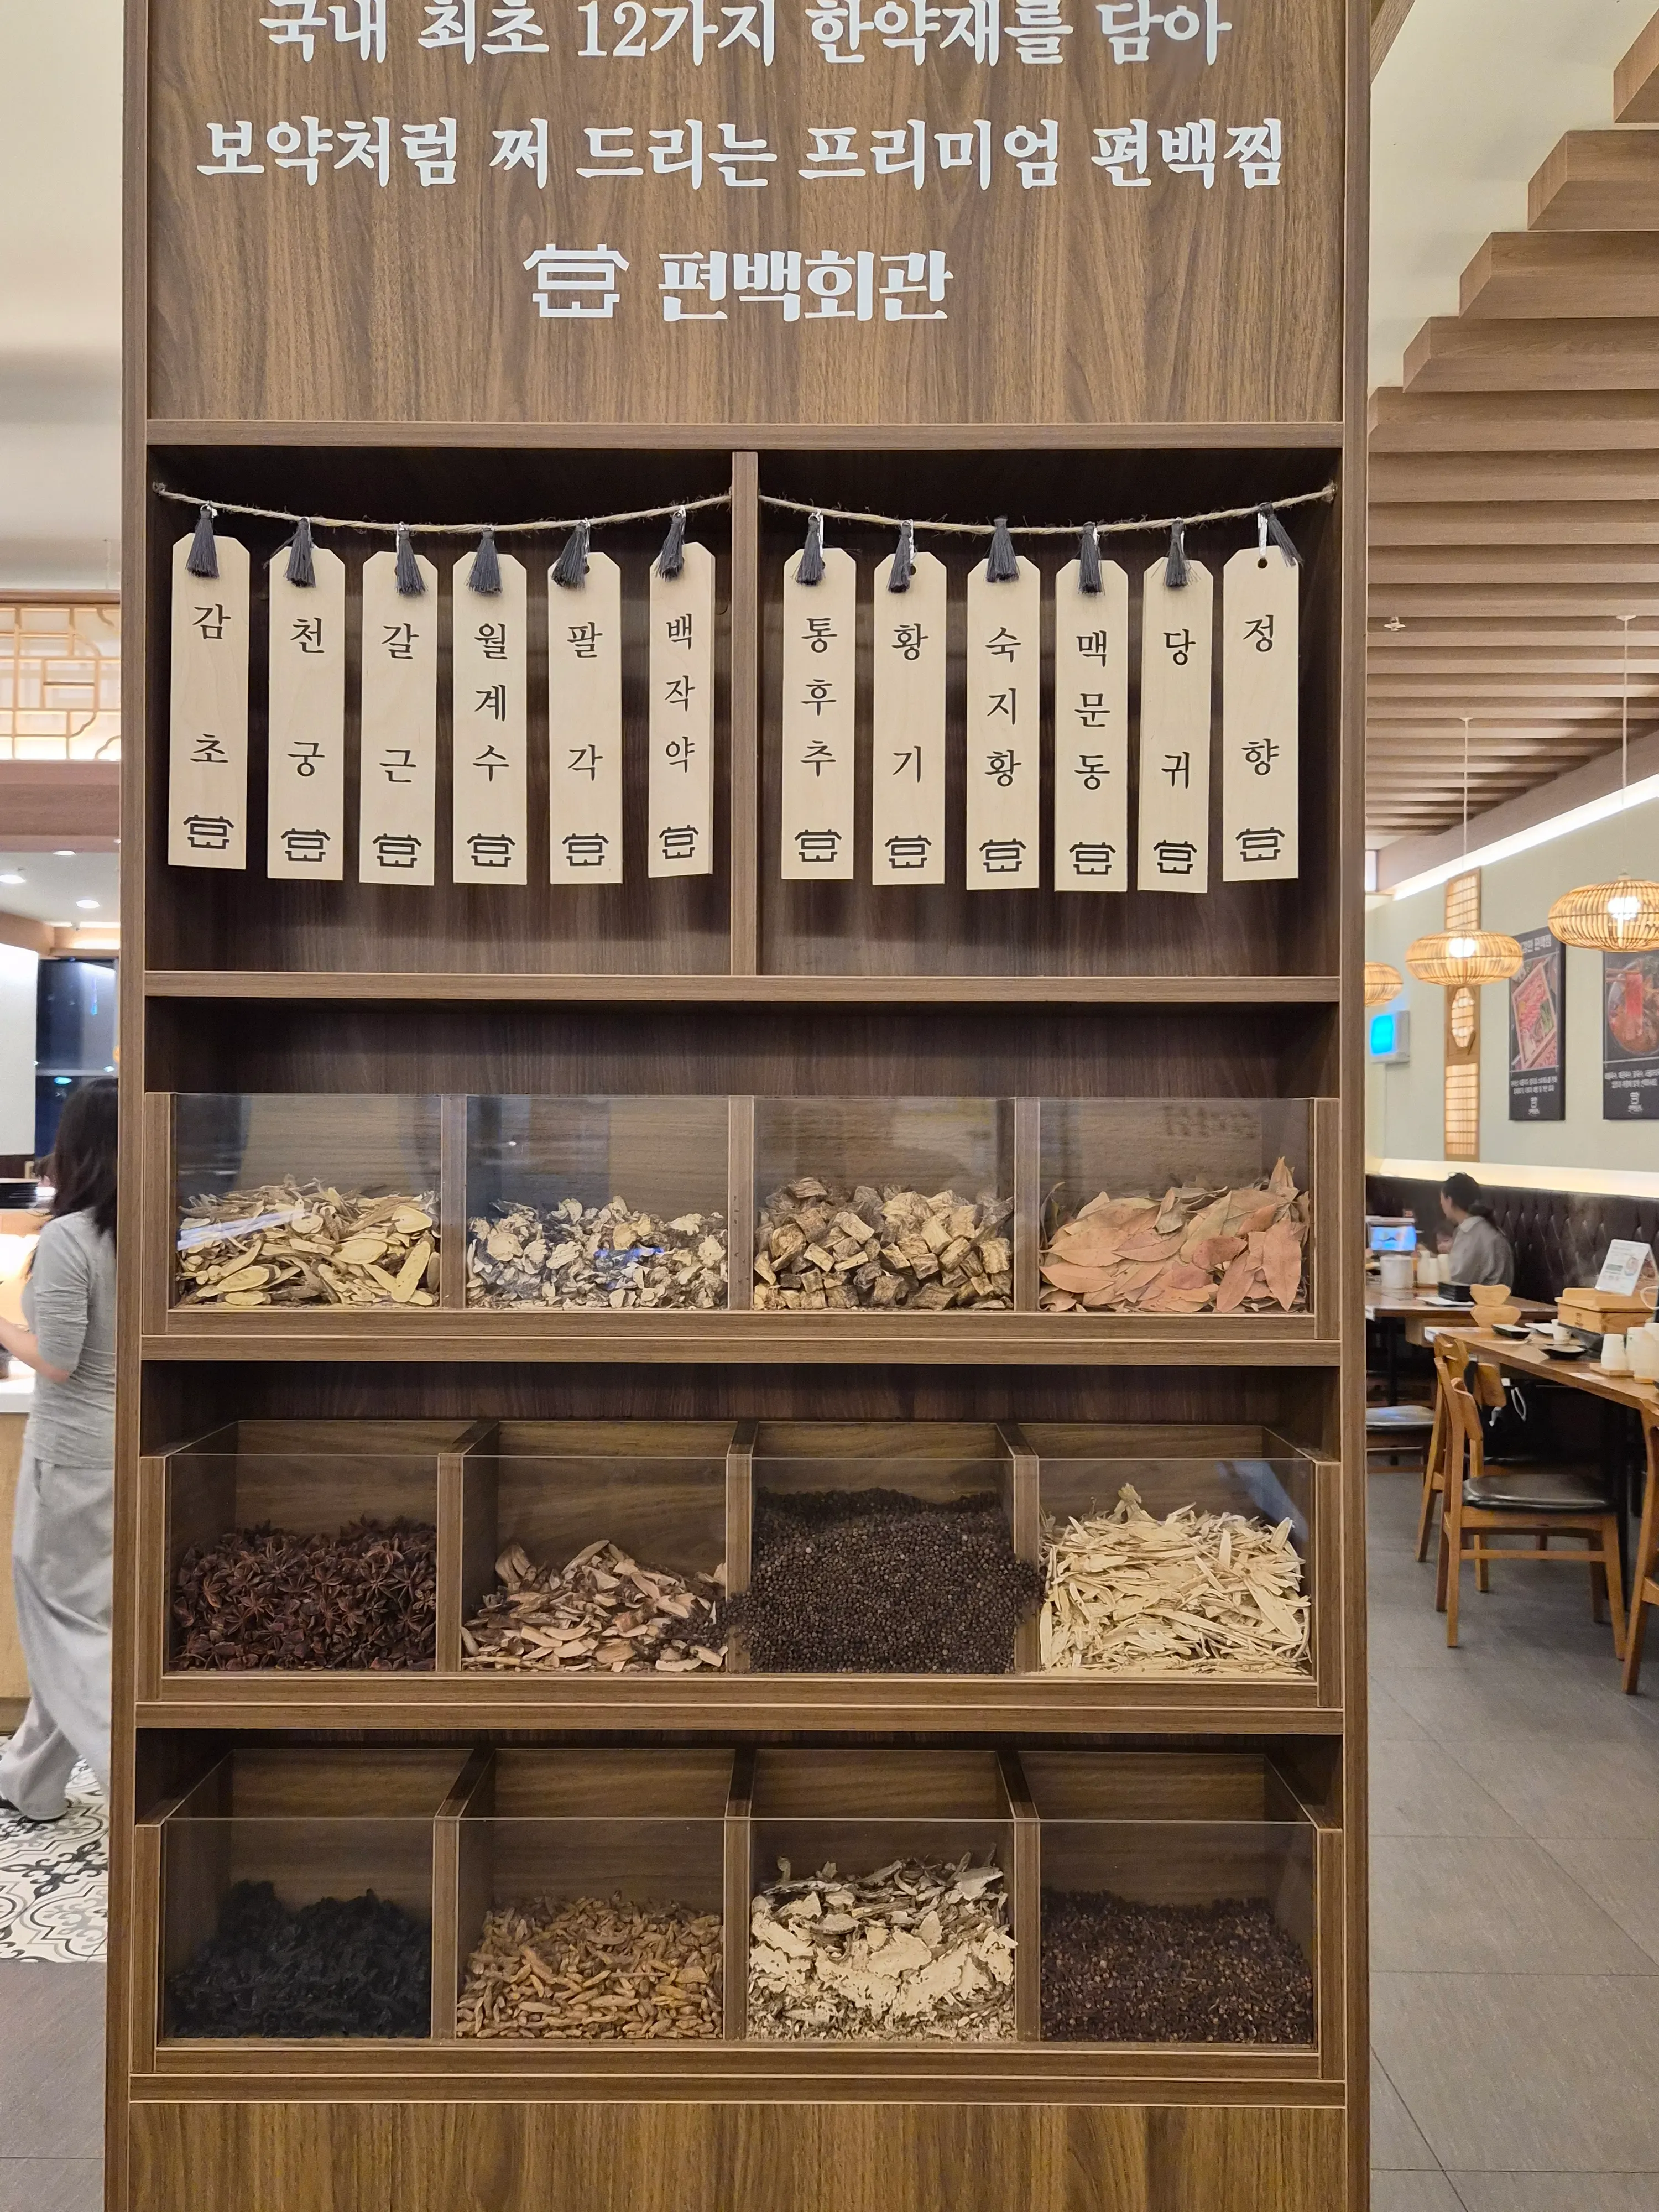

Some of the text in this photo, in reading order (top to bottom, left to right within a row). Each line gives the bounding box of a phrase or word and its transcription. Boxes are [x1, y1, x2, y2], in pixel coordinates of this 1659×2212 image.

[258, 0, 1233, 67] 국내 최초 12가지 한약재를 담아
[196, 115, 457, 187] 보약처럼
[576, 119, 778, 190] 드리는
[797, 119, 1059, 191] 프리미엄
[1091, 118, 1282, 190] 편백찜
[658, 249, 954, 322] 편백회관
[190, 603, 231, 763] 감초
[288, 617, 325, 777] 천궁
[379, 623, 419, 783] 갈근
[472, 623, 509, 782] 월계수
[567, 622, 603, 781] 팔각
[665, 613, 696, 773] 백작약
[801, 618, 838, 777] 통후추
[891, 623, 928, 783] 황기
[985, 627, 1022, 787] 숙지황
[1074, 630, 1110, 790] 맥문동
[1161, 628, 1196, 789] 당귀
[1241, 614, 1279, 776] 정향
